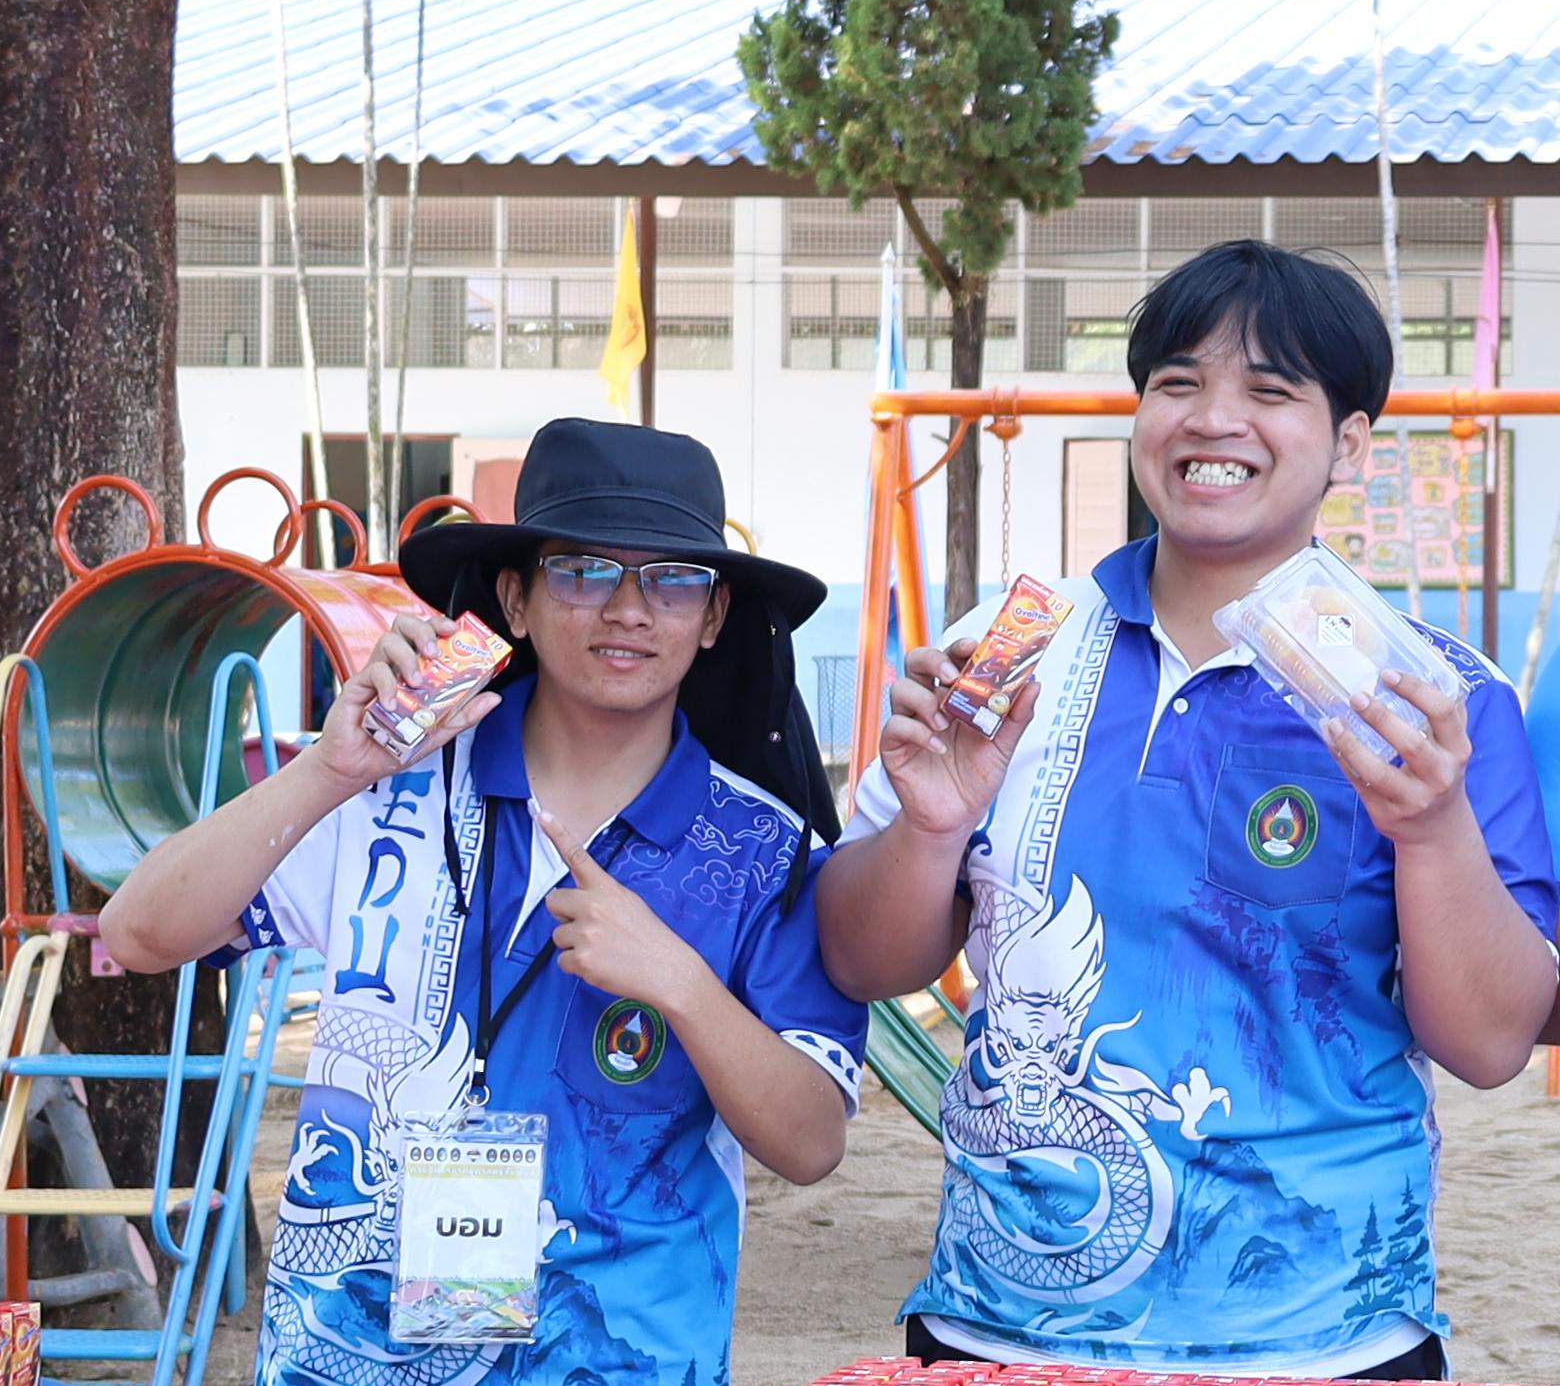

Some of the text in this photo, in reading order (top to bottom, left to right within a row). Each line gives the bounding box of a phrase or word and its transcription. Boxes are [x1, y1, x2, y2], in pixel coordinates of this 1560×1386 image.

[1049, 599, 1064, 611] 10
[1015, 607, 1050, 622] Ovaltine
[490, 638, 503, 651] 10
[436, 1217, 503, 1238] บอม
